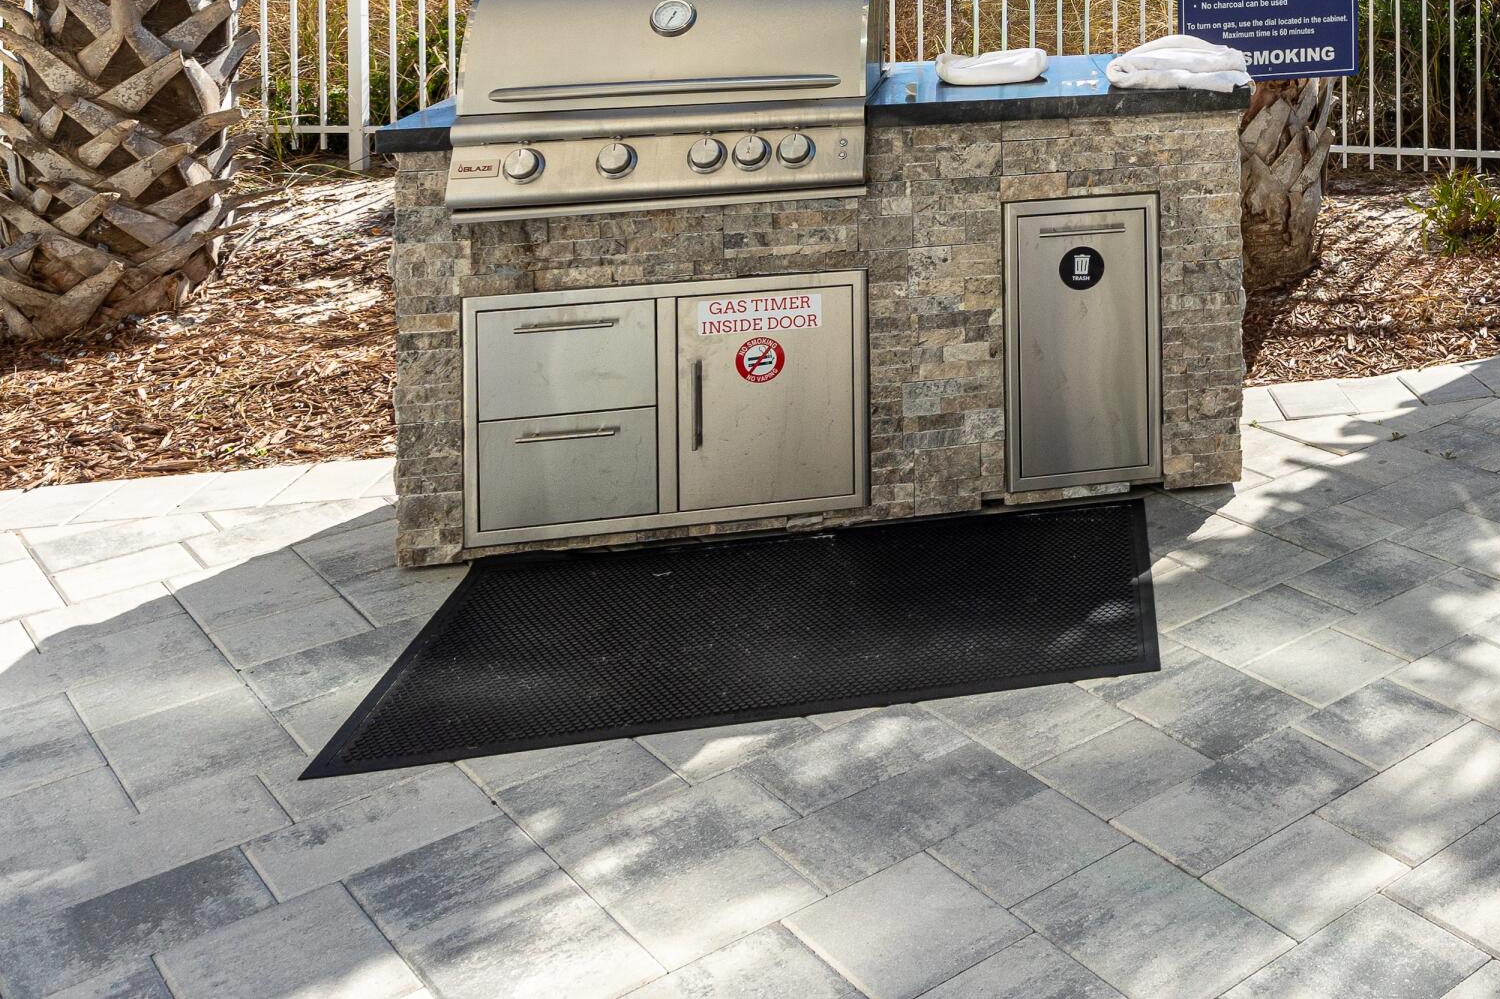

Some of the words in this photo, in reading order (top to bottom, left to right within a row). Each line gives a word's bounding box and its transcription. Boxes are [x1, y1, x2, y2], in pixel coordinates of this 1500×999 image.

[1201, 2, 1212, 10] No
[1213, 0, 1244, 9] charcoal
[1223, 22, 1237, 30] gas,
[1253, 19, 1263, 27] the
[1278, 17, 1301, 25] located
[1323, 15, 1348, 23] cabinet.
[1222, 31, 1255, 39] Maximum
[1256, 30, 1270, 38] time
[1280, 28, 1287, 36] 60
[1243, 46, 1335, 65] SMOKING
[709, 301, 747, 314] GAS
[751, 296, 810, 311] TIMER
[702, 318, 762, 334] INSIDE
[767, 314, 818, 329] DOOR
[746, 338, 778, 349] SMOKING
[757, 368, 778, 381] VAPING
